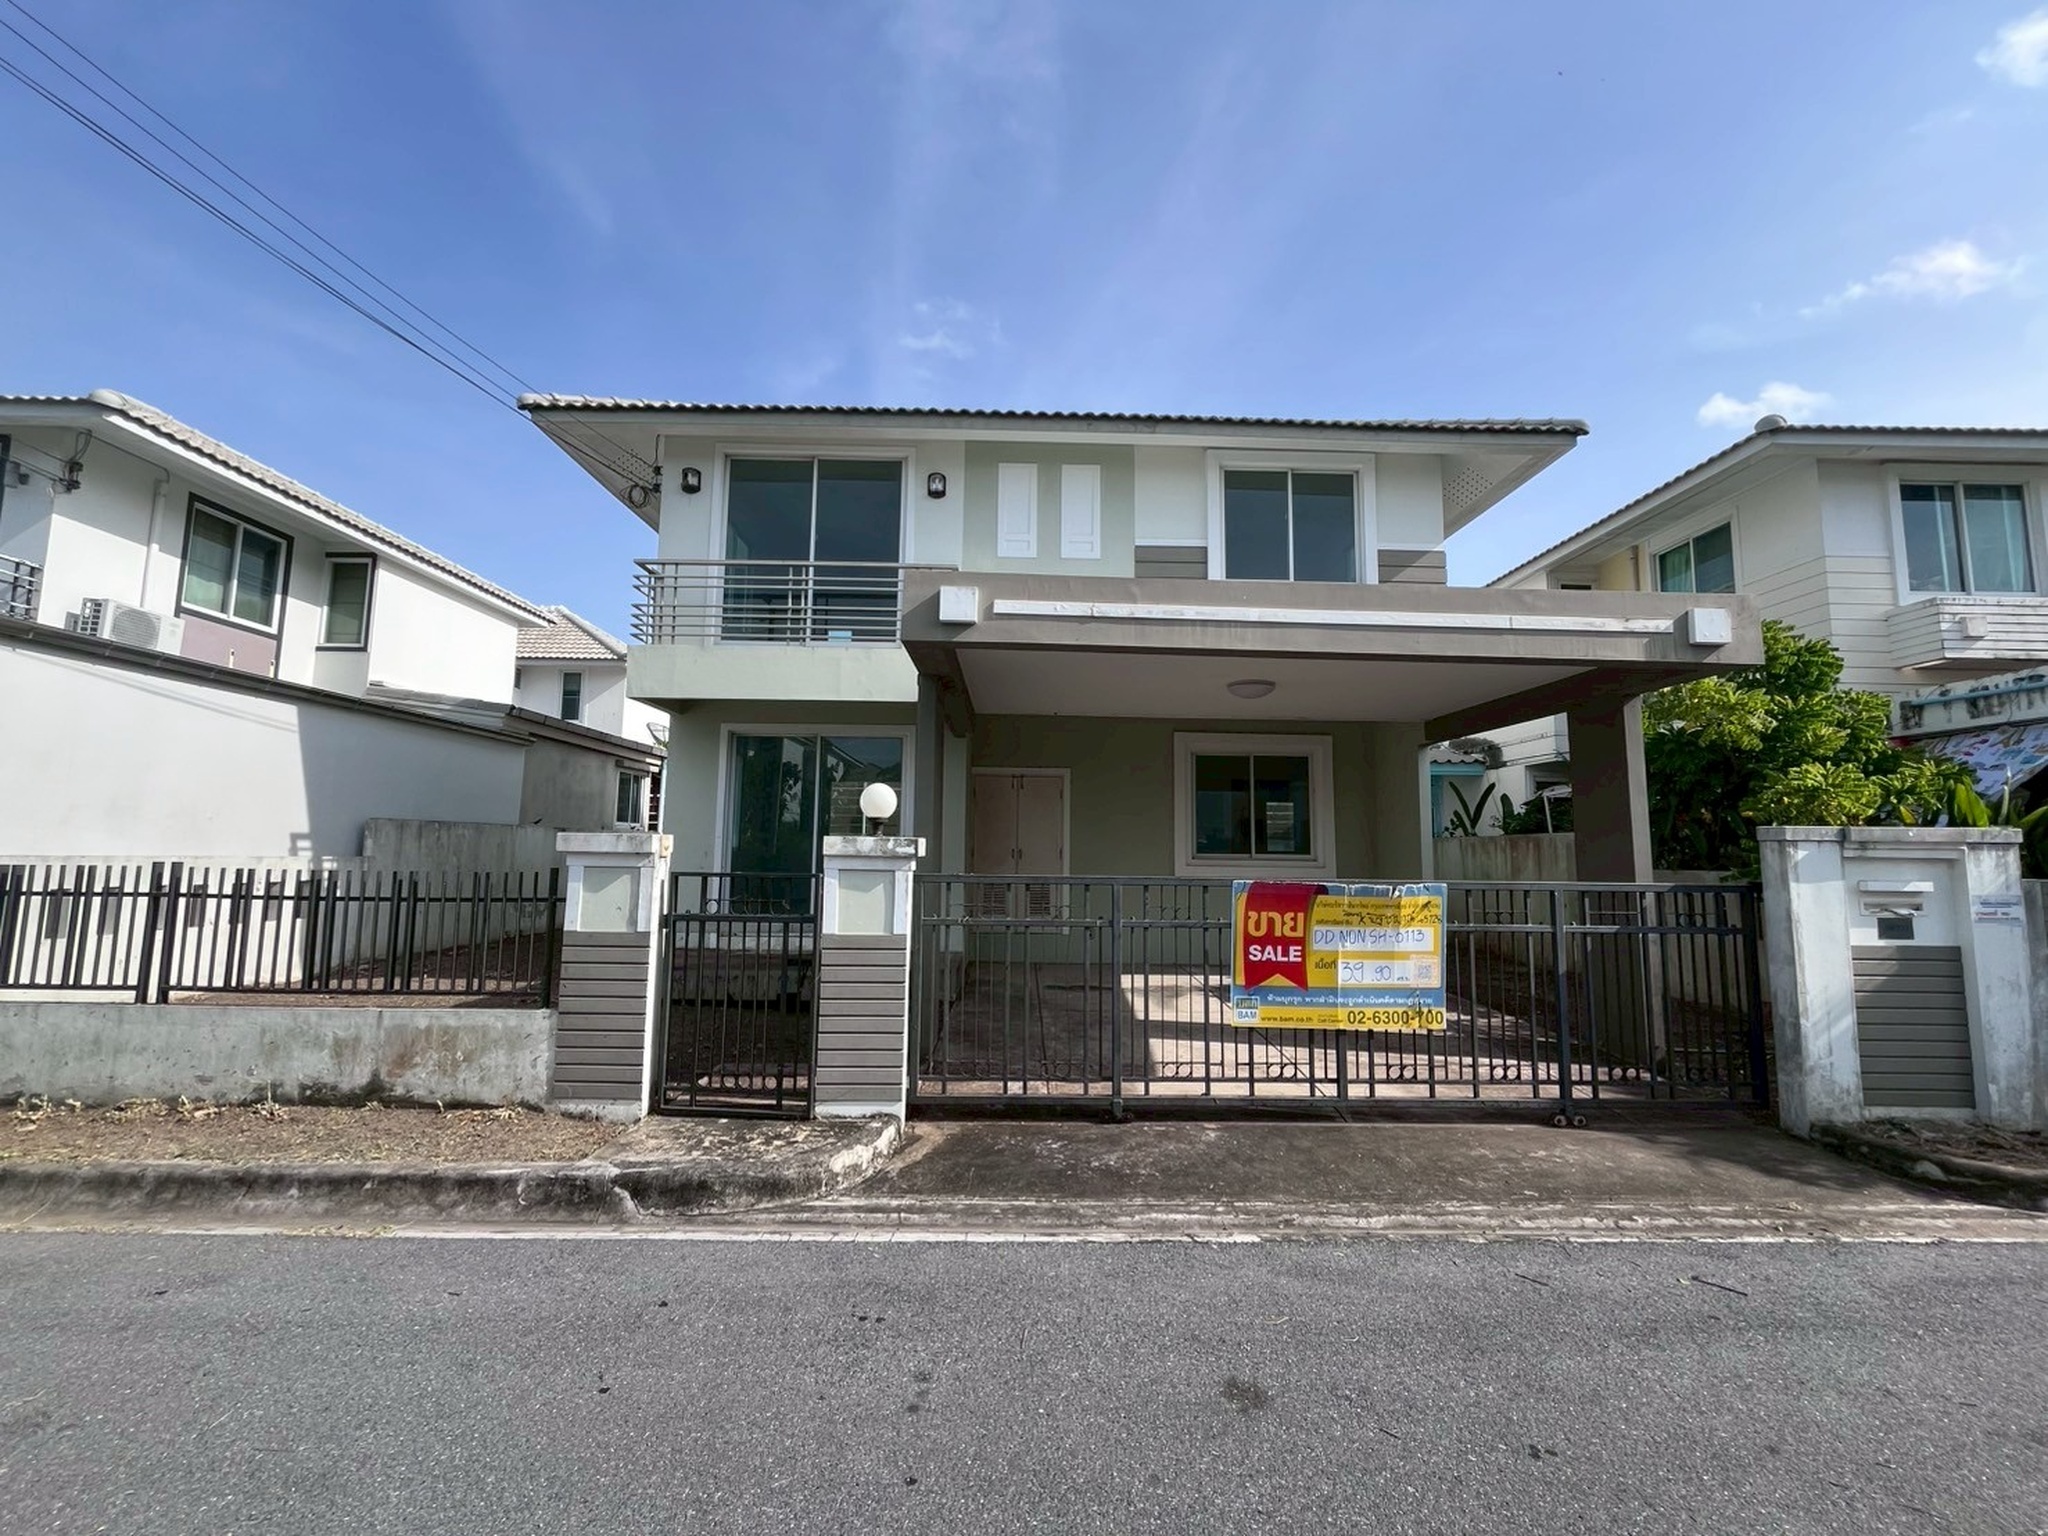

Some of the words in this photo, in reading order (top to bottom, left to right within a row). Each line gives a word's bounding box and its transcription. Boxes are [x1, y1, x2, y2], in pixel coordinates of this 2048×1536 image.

[1248, 911, 1304, 937] ขาย
[1248, 945, 1302, 962] SALE
[1237, 1010, 1257, 1020] BAM
[1261, 1015, 1314, 1023] www.bam.co.th
